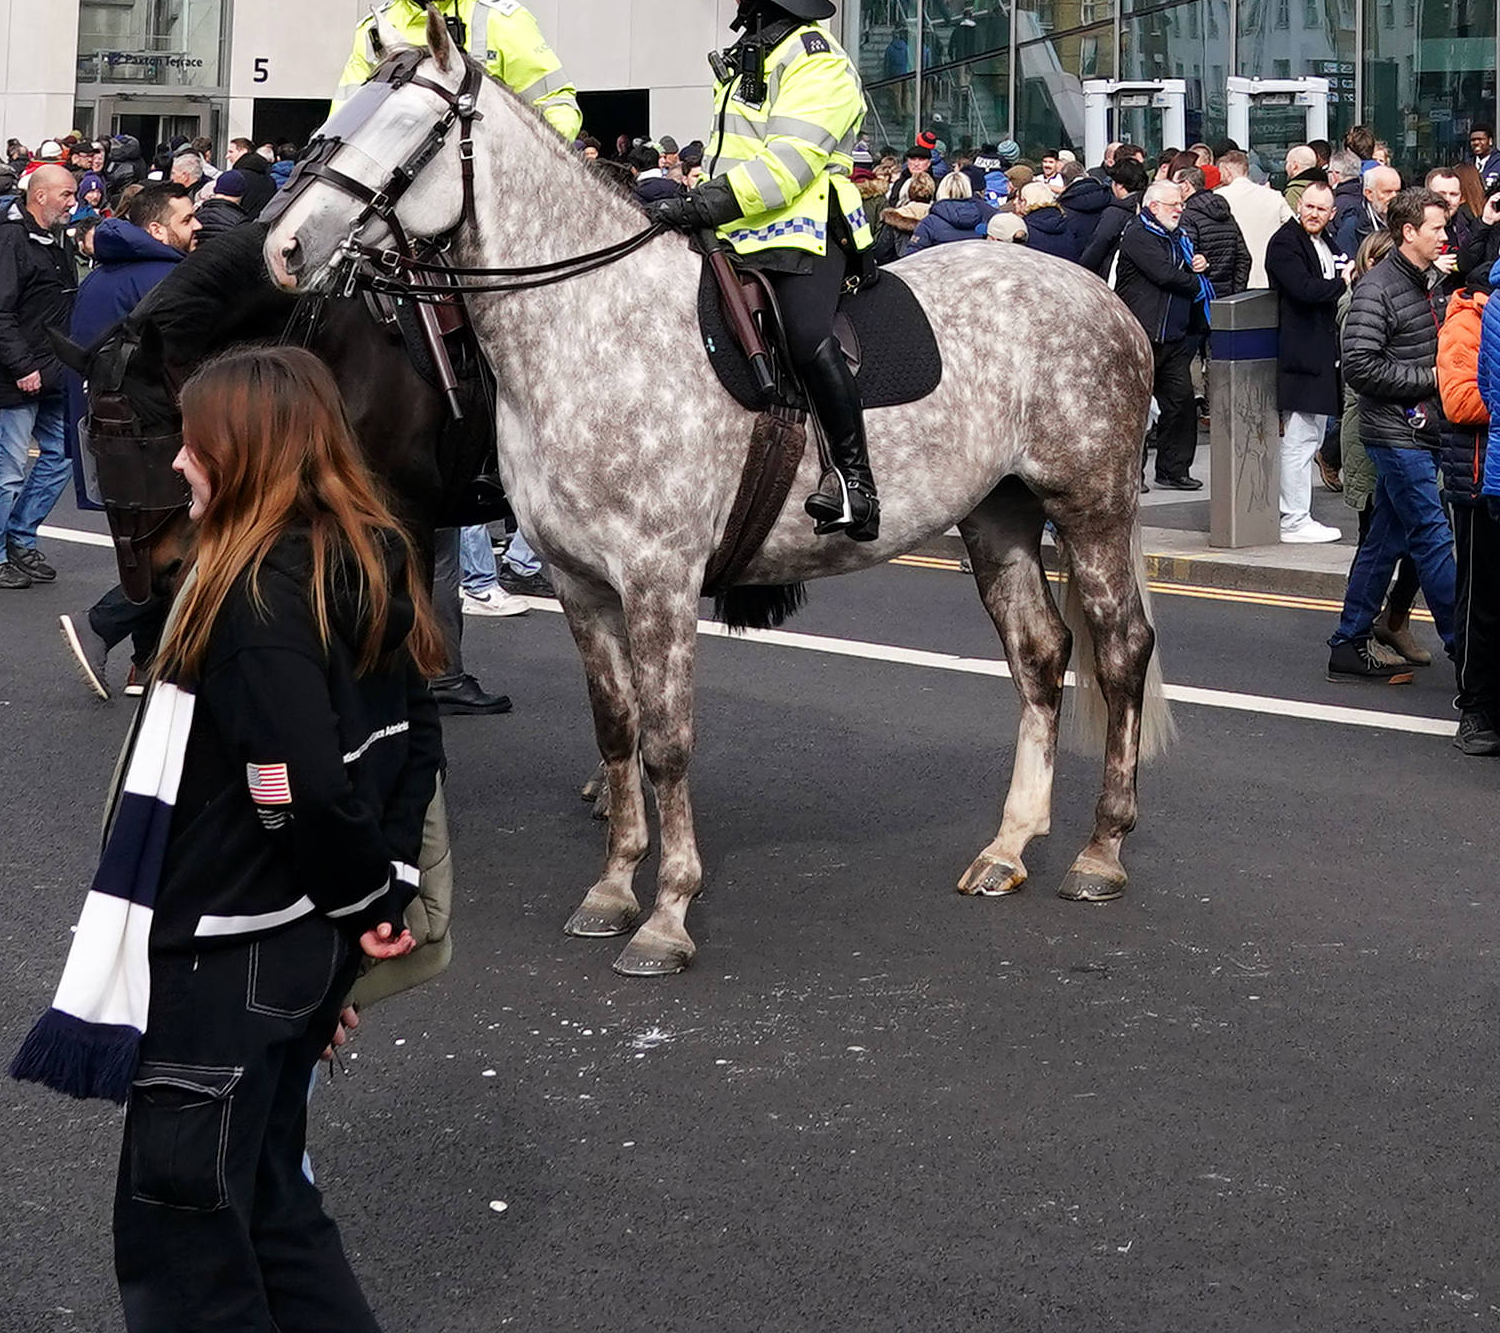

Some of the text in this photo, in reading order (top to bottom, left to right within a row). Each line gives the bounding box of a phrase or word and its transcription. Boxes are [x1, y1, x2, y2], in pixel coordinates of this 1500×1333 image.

[125, 53, 204, 68] Paxton Terrace
[252, 58, 269, 83] 5
